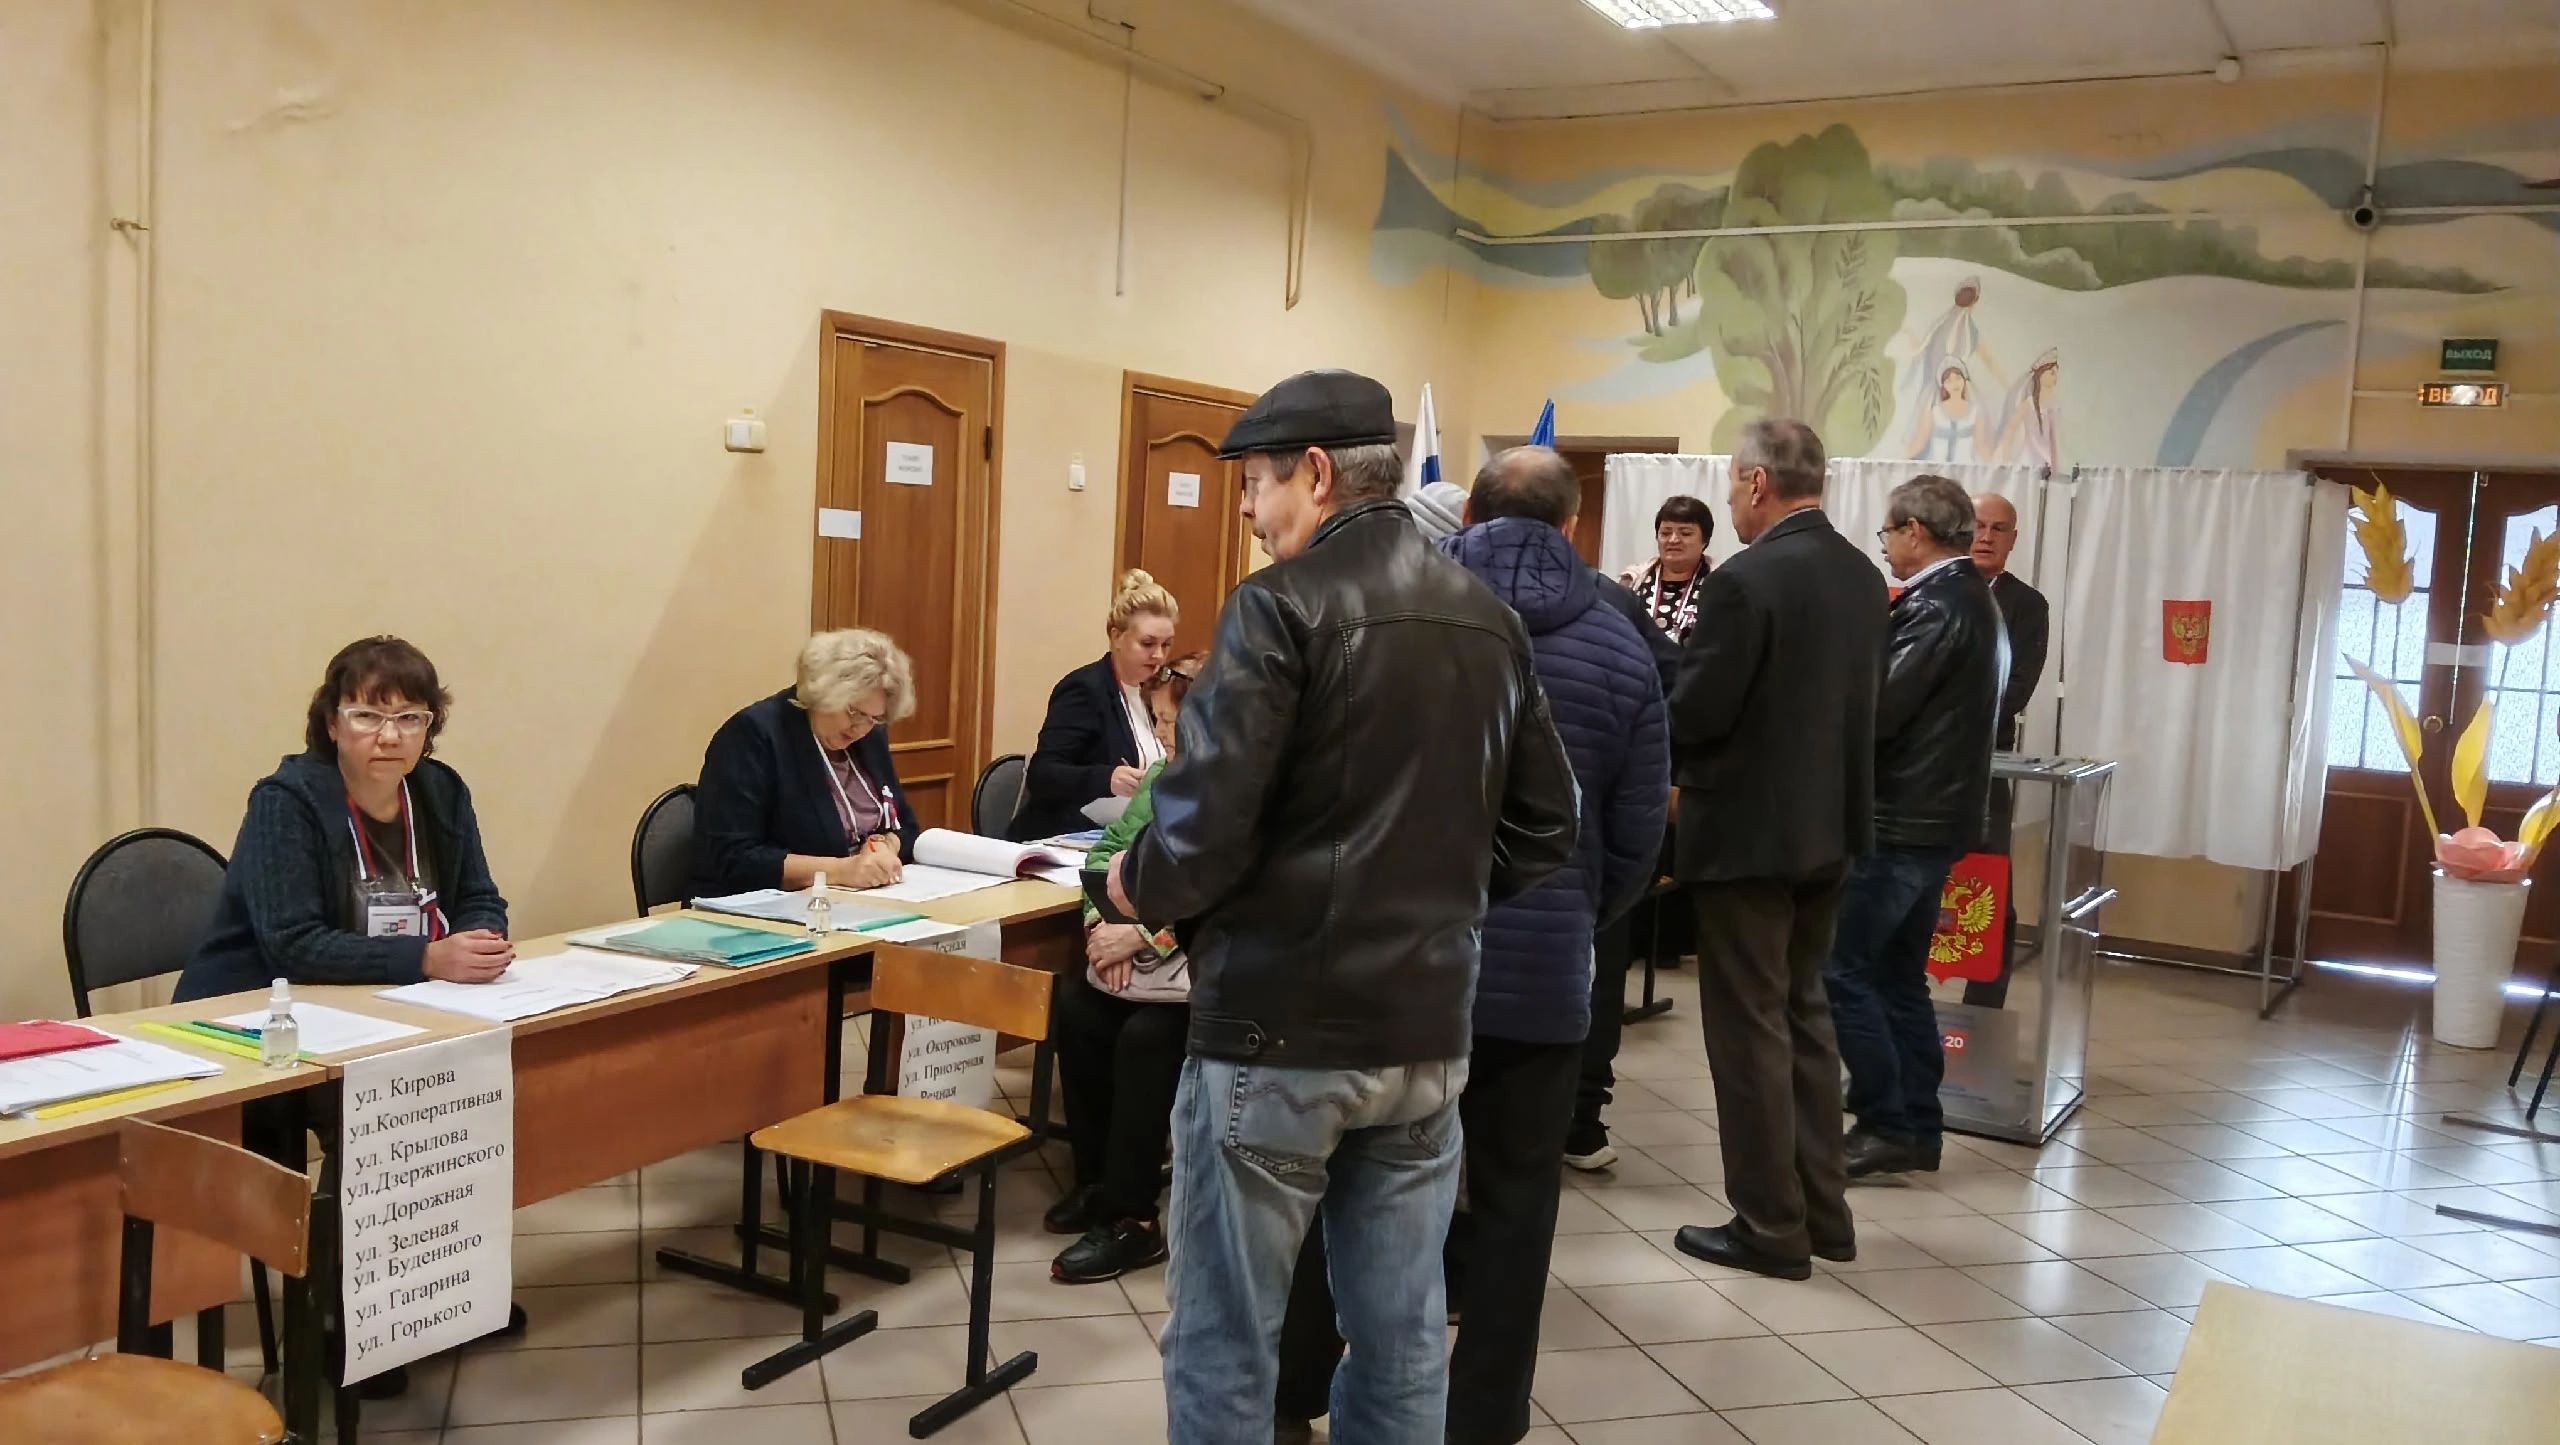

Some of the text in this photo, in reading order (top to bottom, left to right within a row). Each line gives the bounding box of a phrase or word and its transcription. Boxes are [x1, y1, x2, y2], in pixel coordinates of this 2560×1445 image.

[2445, 349, 2492, 360] ВЫХОД
[926, 1034, 981, 1054] Окорокова
[1945, 1035, 1964, 1048] 20
[355, 1069, 456, 1112] ул. Кирова
[924, 1056, 984, 1080] Приозерная
[355, 1128, 469, 1176] ул. Крылова
[353, 1233, 482, 1294] ул. Буденного
[355, 1218, 460, 1270] ул. Зеленая
[355, 1269, 471, 1328] ул. Гагарина
[357, 1299, 472, 1360] ул. Горького
